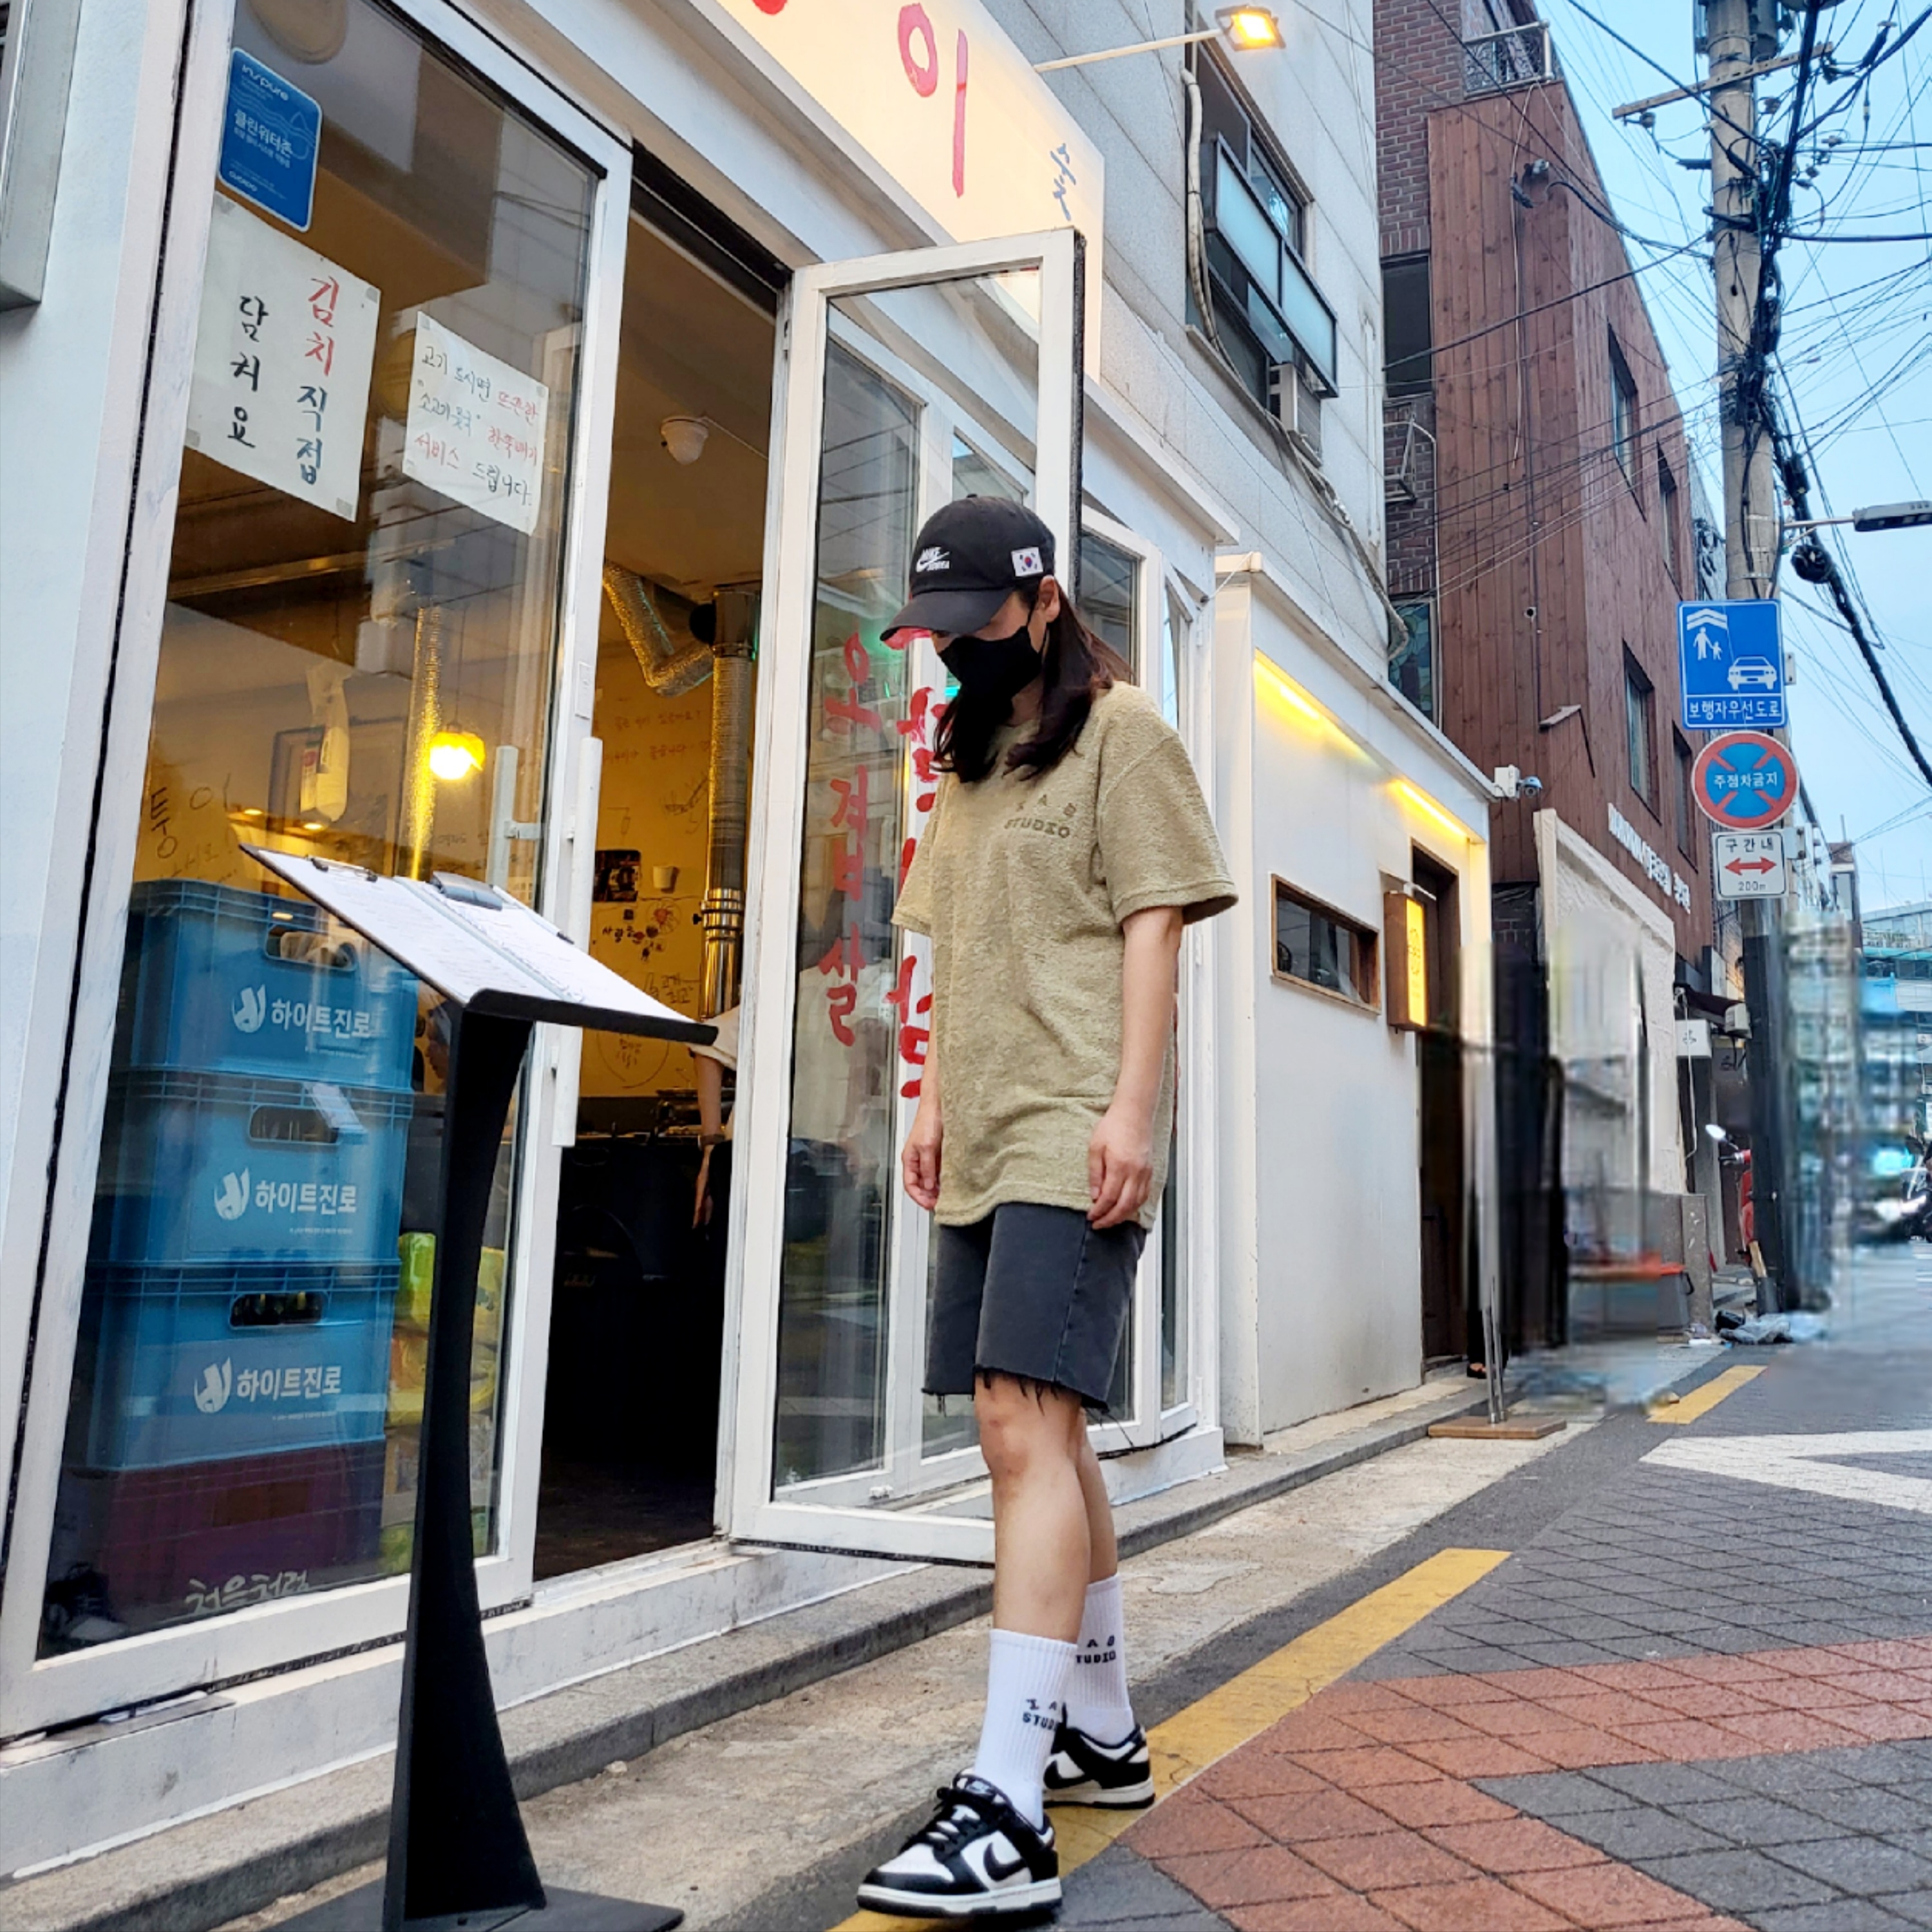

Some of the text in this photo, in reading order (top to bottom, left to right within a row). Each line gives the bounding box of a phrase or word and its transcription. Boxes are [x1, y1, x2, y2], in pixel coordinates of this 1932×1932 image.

[297, 276, 339, 485] 김치 직접
[421, 346, 448, 375] 고기
[453, 366, 491, 402] 드시면
[414, 432, 459, 470] 서비스
[1689, 699, 1781, 721] 보행자우선도로
[1004, 817, 1070, 838] STUDIO
[1738, 881, 1766, 891] 200m
[271, 998, 372, 1039] 하이트진로
[255, 1179, 357, 1215] 하이트진로
[237, 1365, 342, 1403] 하이트진로
[1075, 1650, 1116, 1663] TUDIO
[1023, 1712, 1057, 1730] STUD
